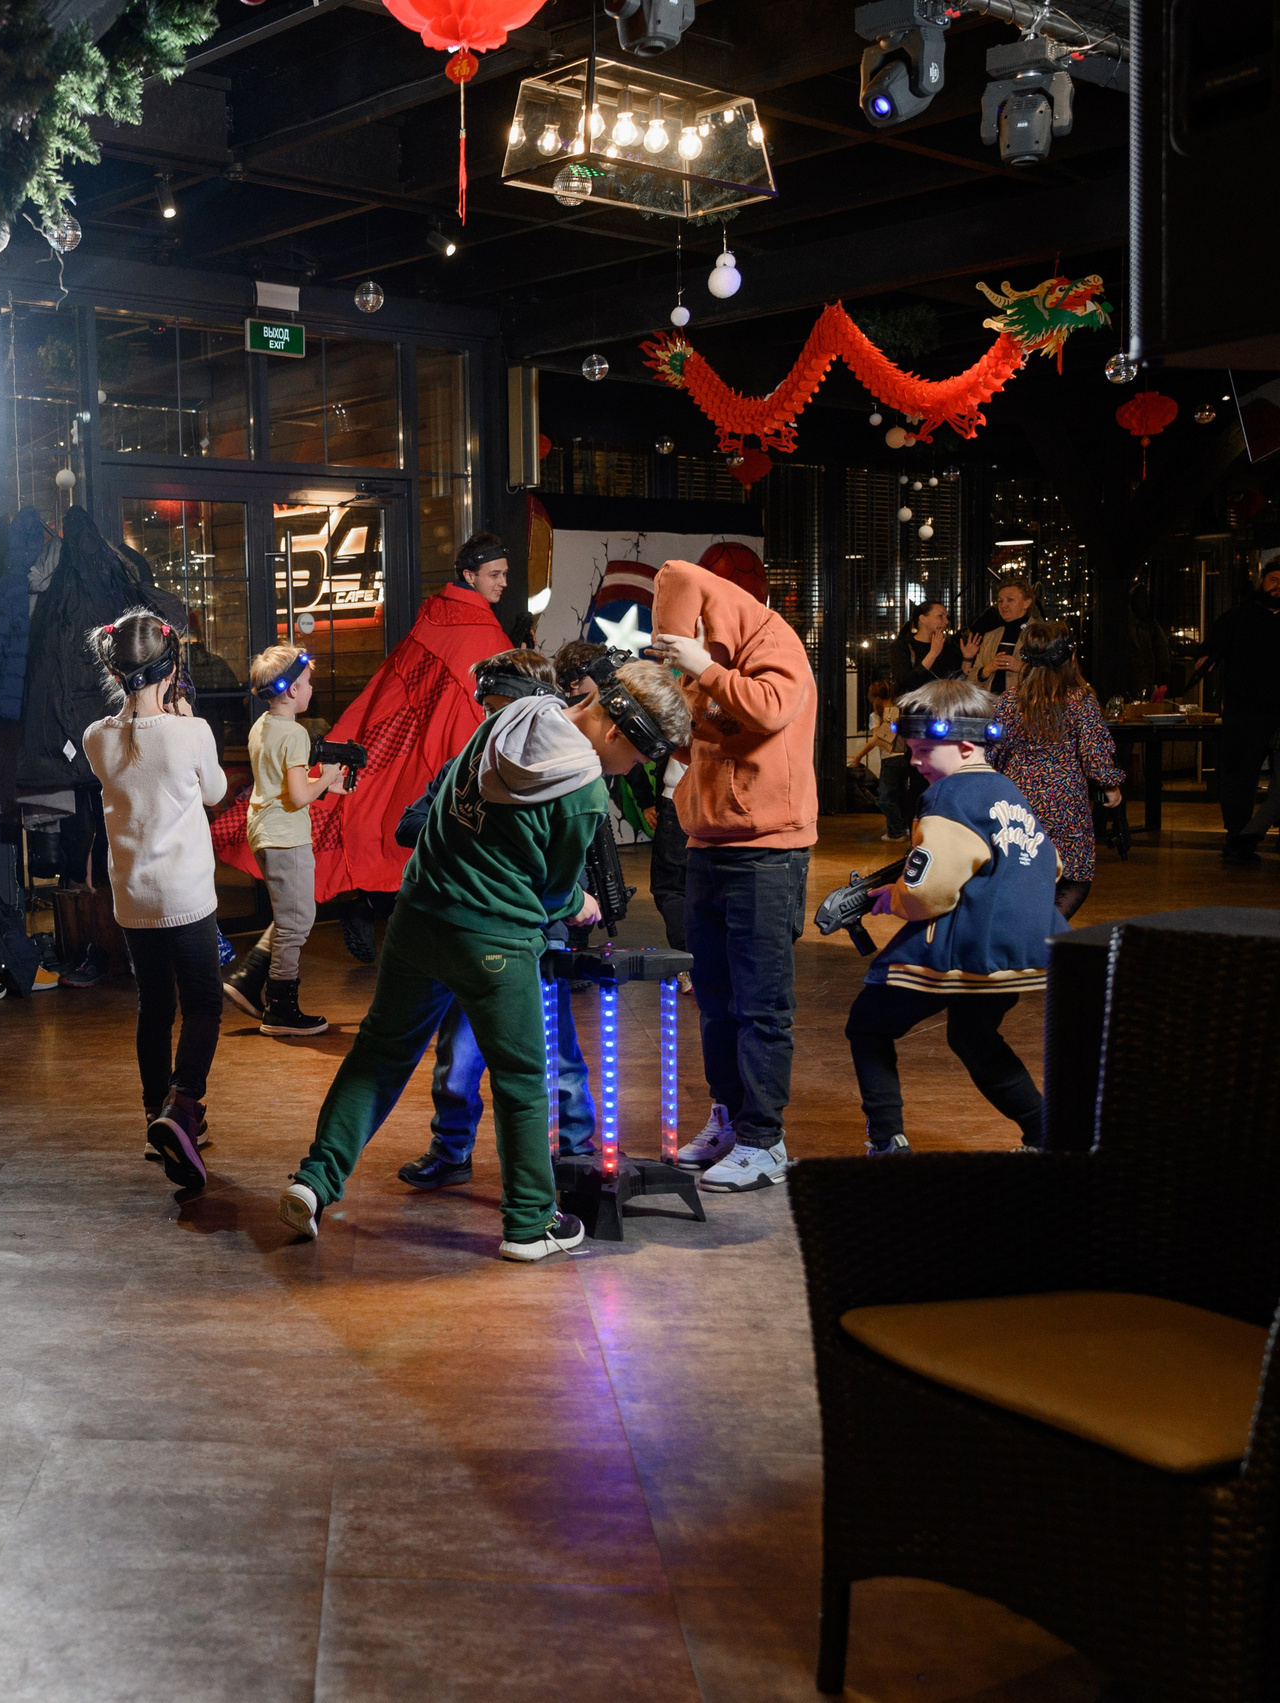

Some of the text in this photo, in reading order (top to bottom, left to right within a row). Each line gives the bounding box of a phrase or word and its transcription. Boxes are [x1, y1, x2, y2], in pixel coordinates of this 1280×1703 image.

[263, 326, 290, 342] ВЫХОД
[269, 340, 285, 350] EXIT
[335, 589, 375, 604] CAFE
